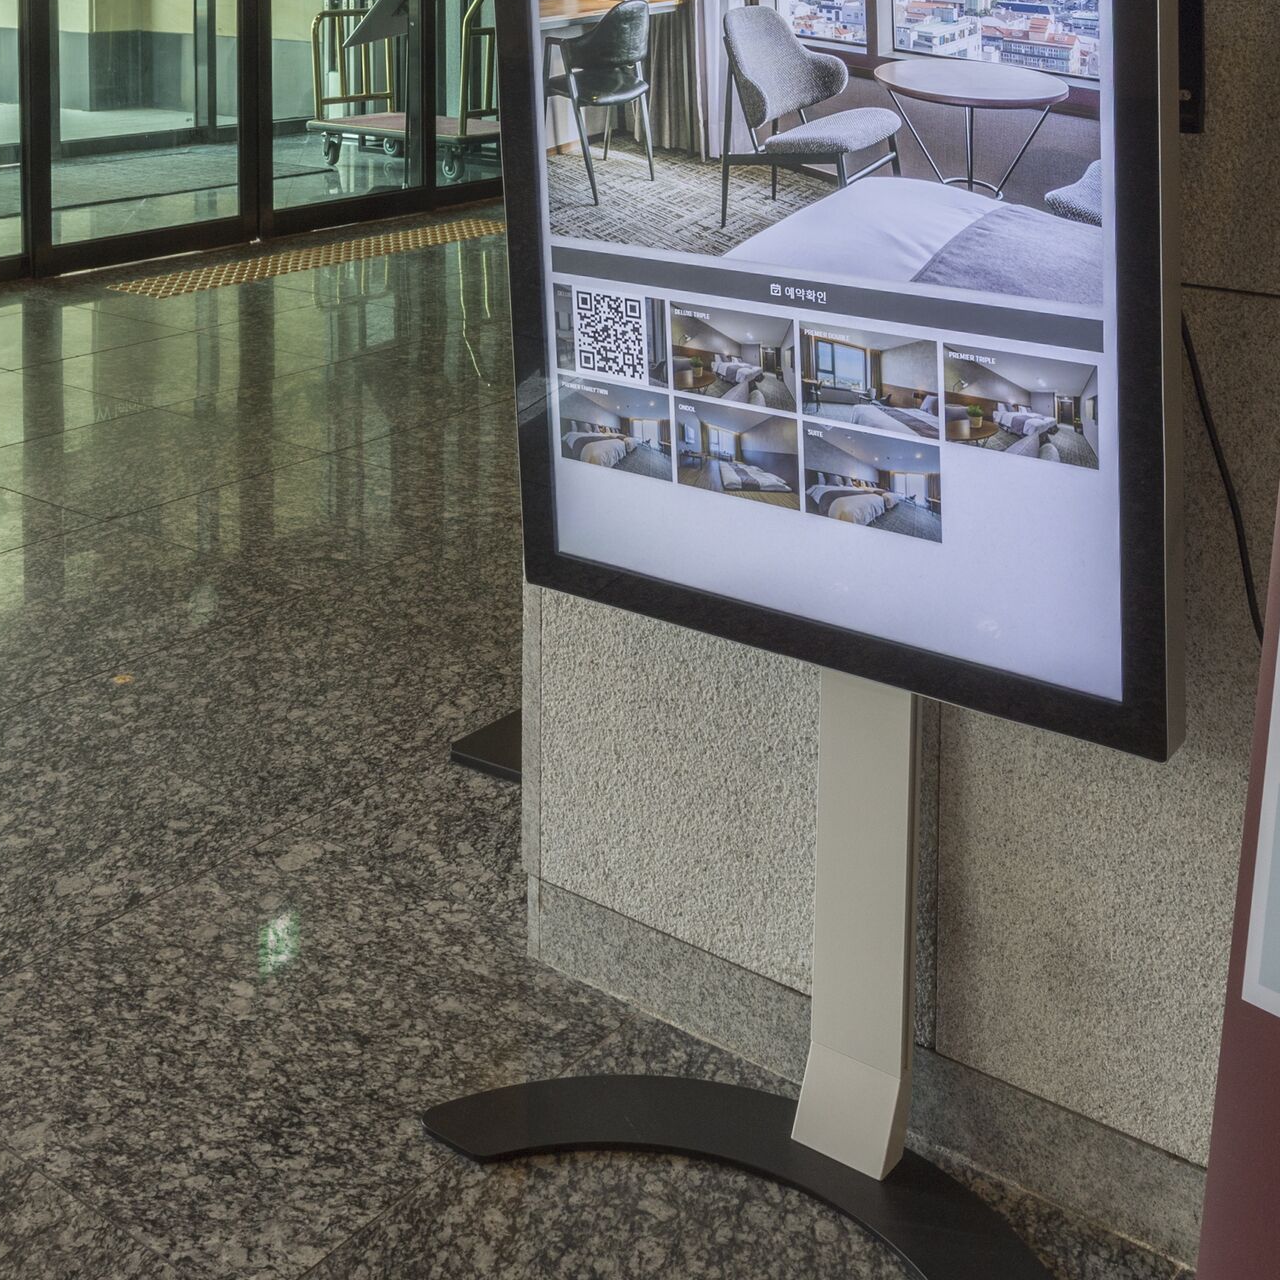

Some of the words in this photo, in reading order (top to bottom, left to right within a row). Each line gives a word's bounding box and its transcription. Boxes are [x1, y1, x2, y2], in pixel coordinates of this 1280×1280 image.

[785, 286, 827, 304] 예약확인
[949, 351, 974, 362] PREMIER
[975, 355, 996, 365] TRIPLE
[807, 429, 823, 438] SUITE
